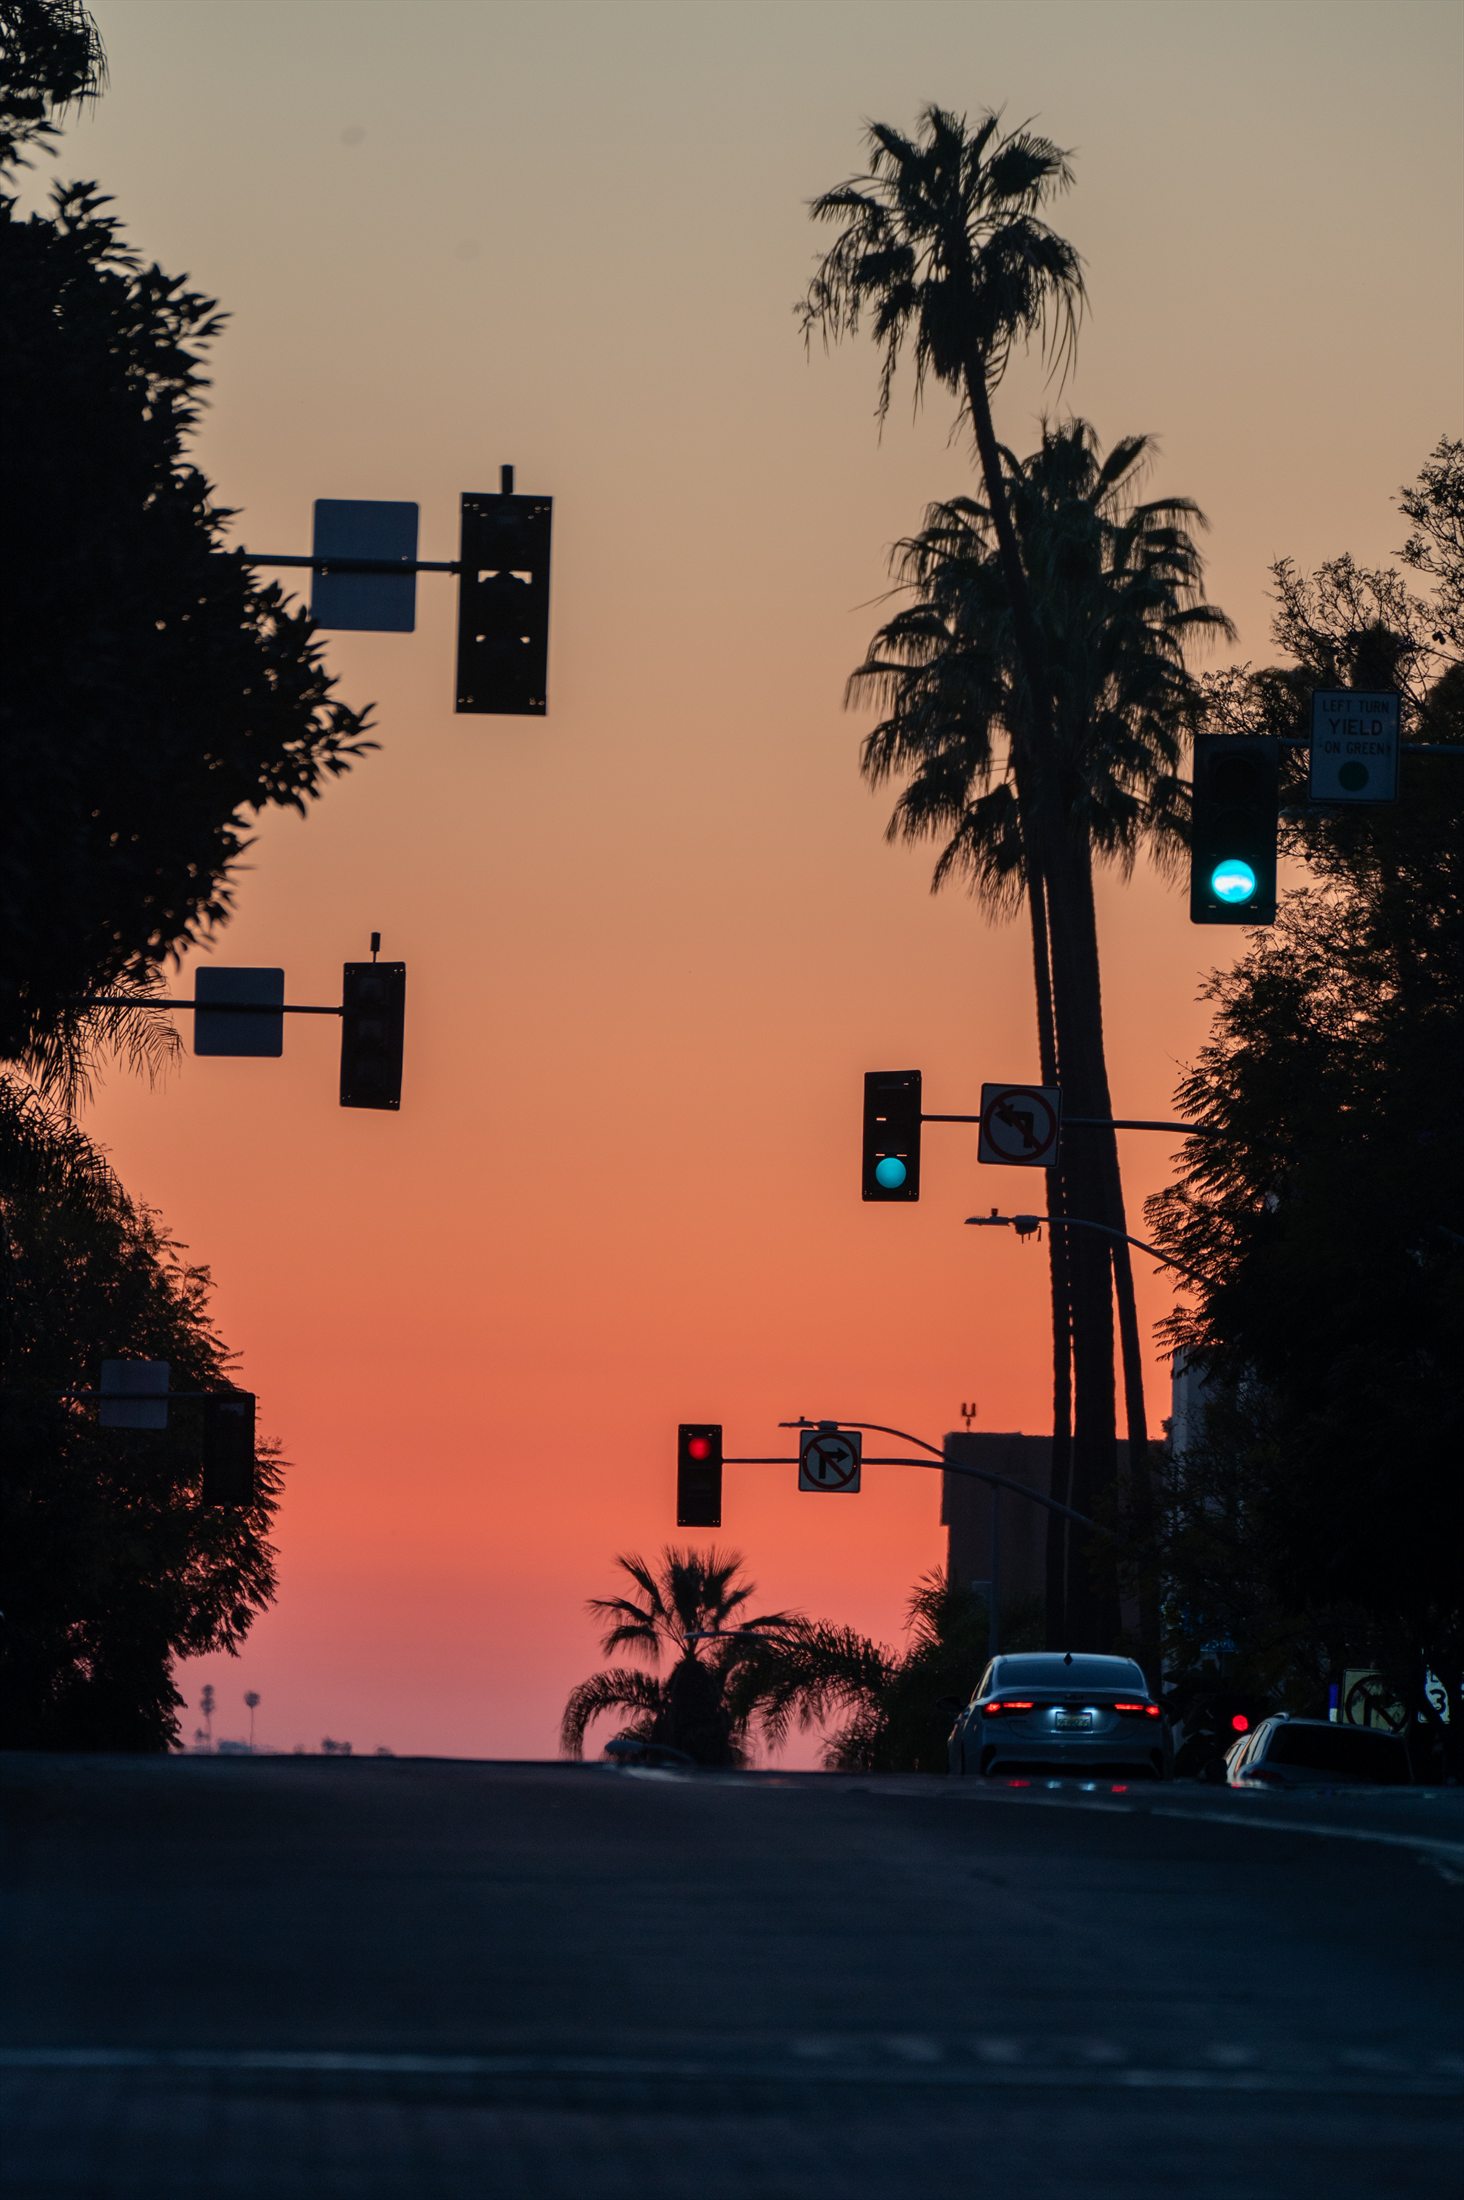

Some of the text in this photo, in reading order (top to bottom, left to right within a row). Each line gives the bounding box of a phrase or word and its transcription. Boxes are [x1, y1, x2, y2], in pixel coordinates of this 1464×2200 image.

[1322, 699, 1389, 713] LEFT TURN
[1328, 718, 1383, 736] YIELD
[1324, 741, 1385, 755] ON GREEN
